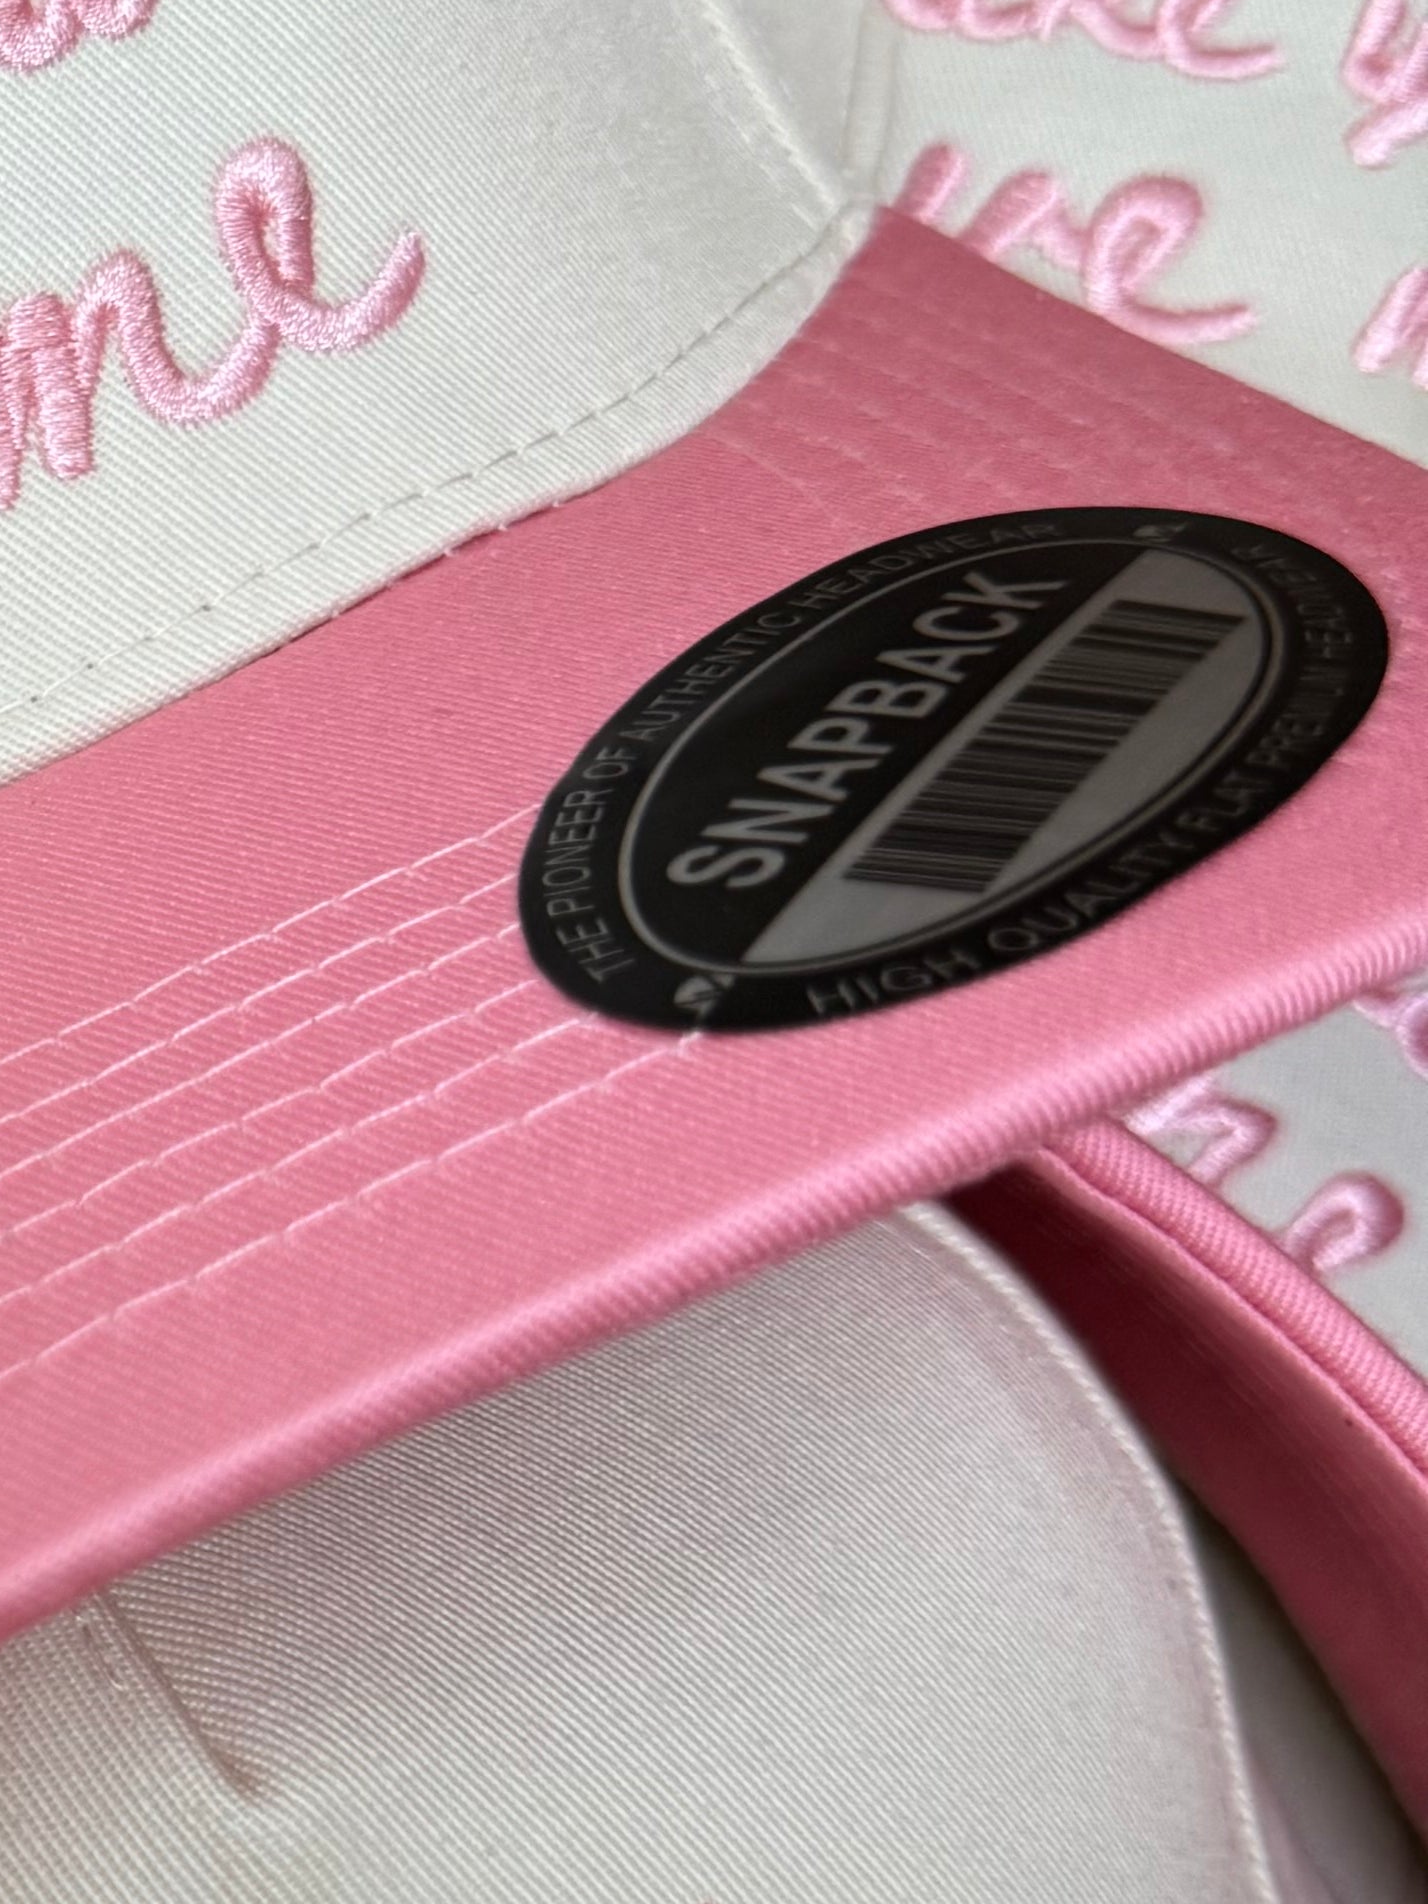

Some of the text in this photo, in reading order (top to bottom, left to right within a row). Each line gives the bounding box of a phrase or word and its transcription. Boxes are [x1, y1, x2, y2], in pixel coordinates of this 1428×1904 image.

[541, 523, 1062, 983] THE PIONEER OF AUTHENTIC HEADWEAR
[666, 571, 1068, 889] SNAPBACK
